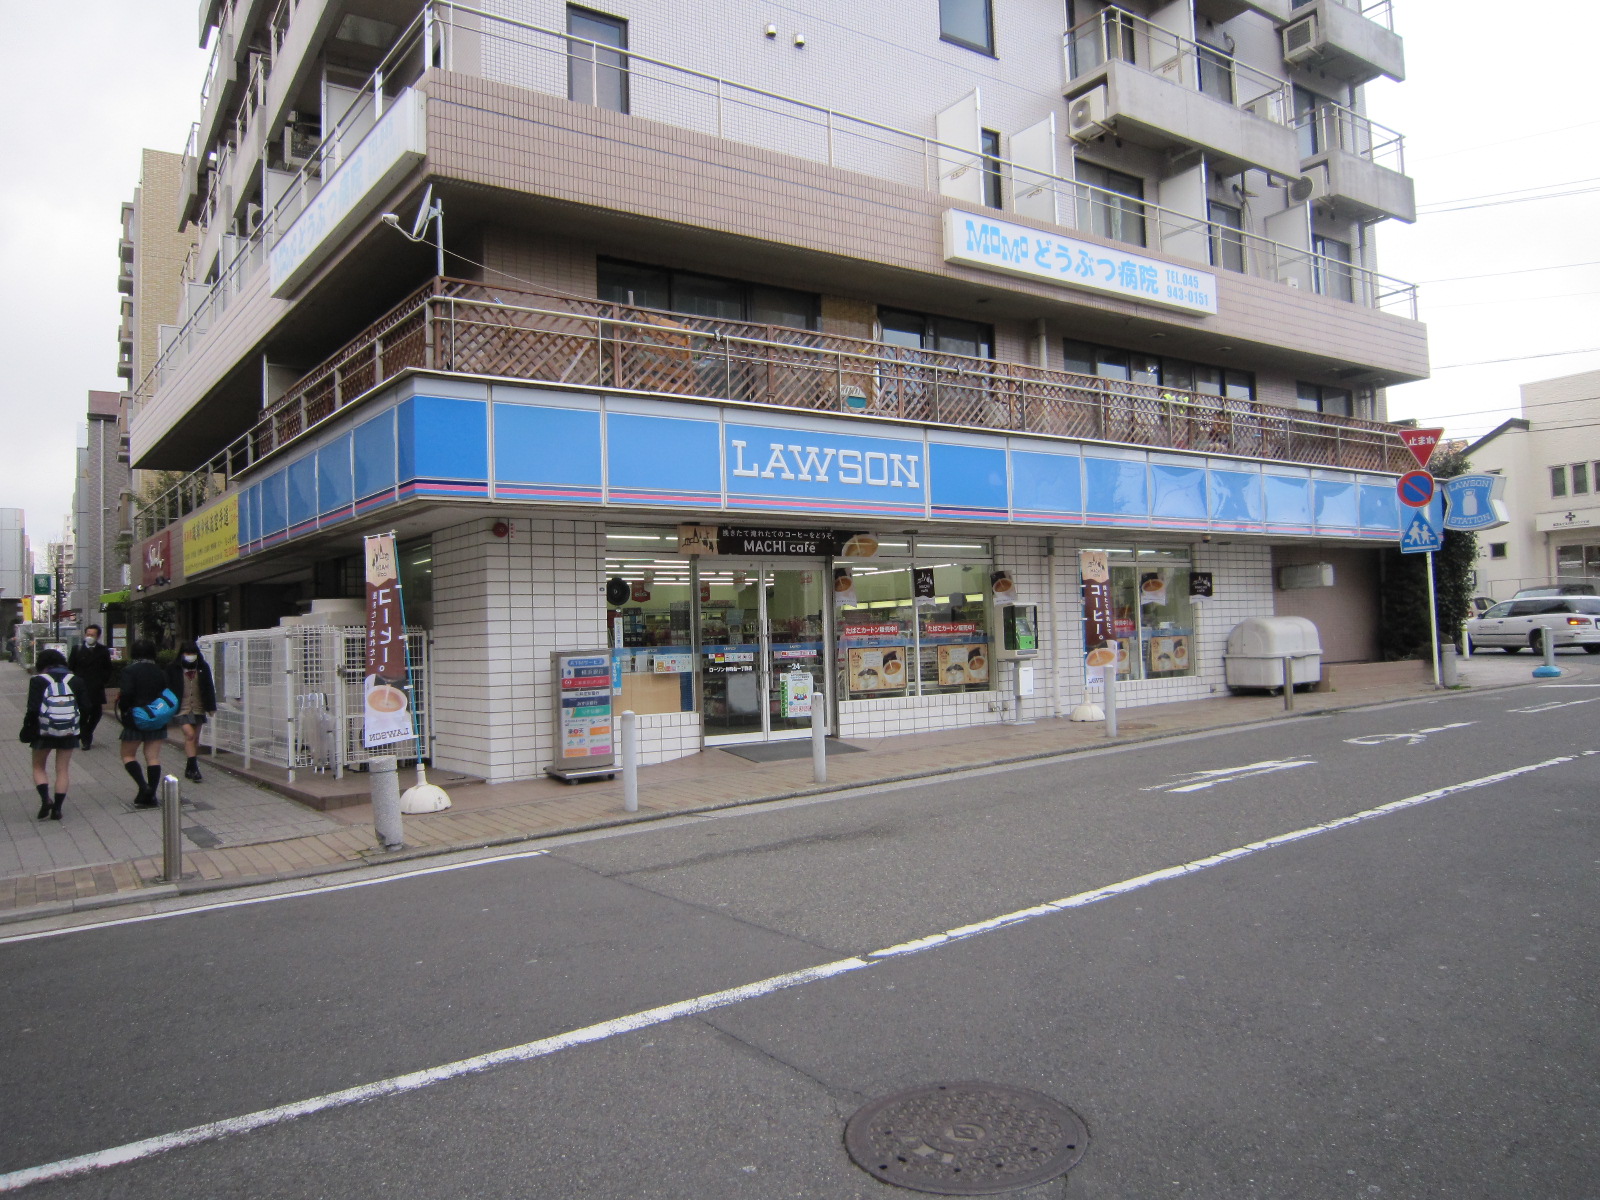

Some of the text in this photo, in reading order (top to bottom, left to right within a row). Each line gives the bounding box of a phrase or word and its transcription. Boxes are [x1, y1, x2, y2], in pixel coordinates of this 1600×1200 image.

[1034, 239, 1159, 295] どうぶつ病院
[1166, 269, 1199, 289] TEL.045
[1167, 285, 1209, 306] 943-0151
[1409, 436, 1435, 446] 止まれ
[732, 440, 920, 488] LAWSON
[1449, 480, 1489, 492] LAWSON
[1451, 513, 1490, 524] STATION
[744, 540, 816, 553] MACHI café
[1091, 584, 1104, 640] コーヒー。
